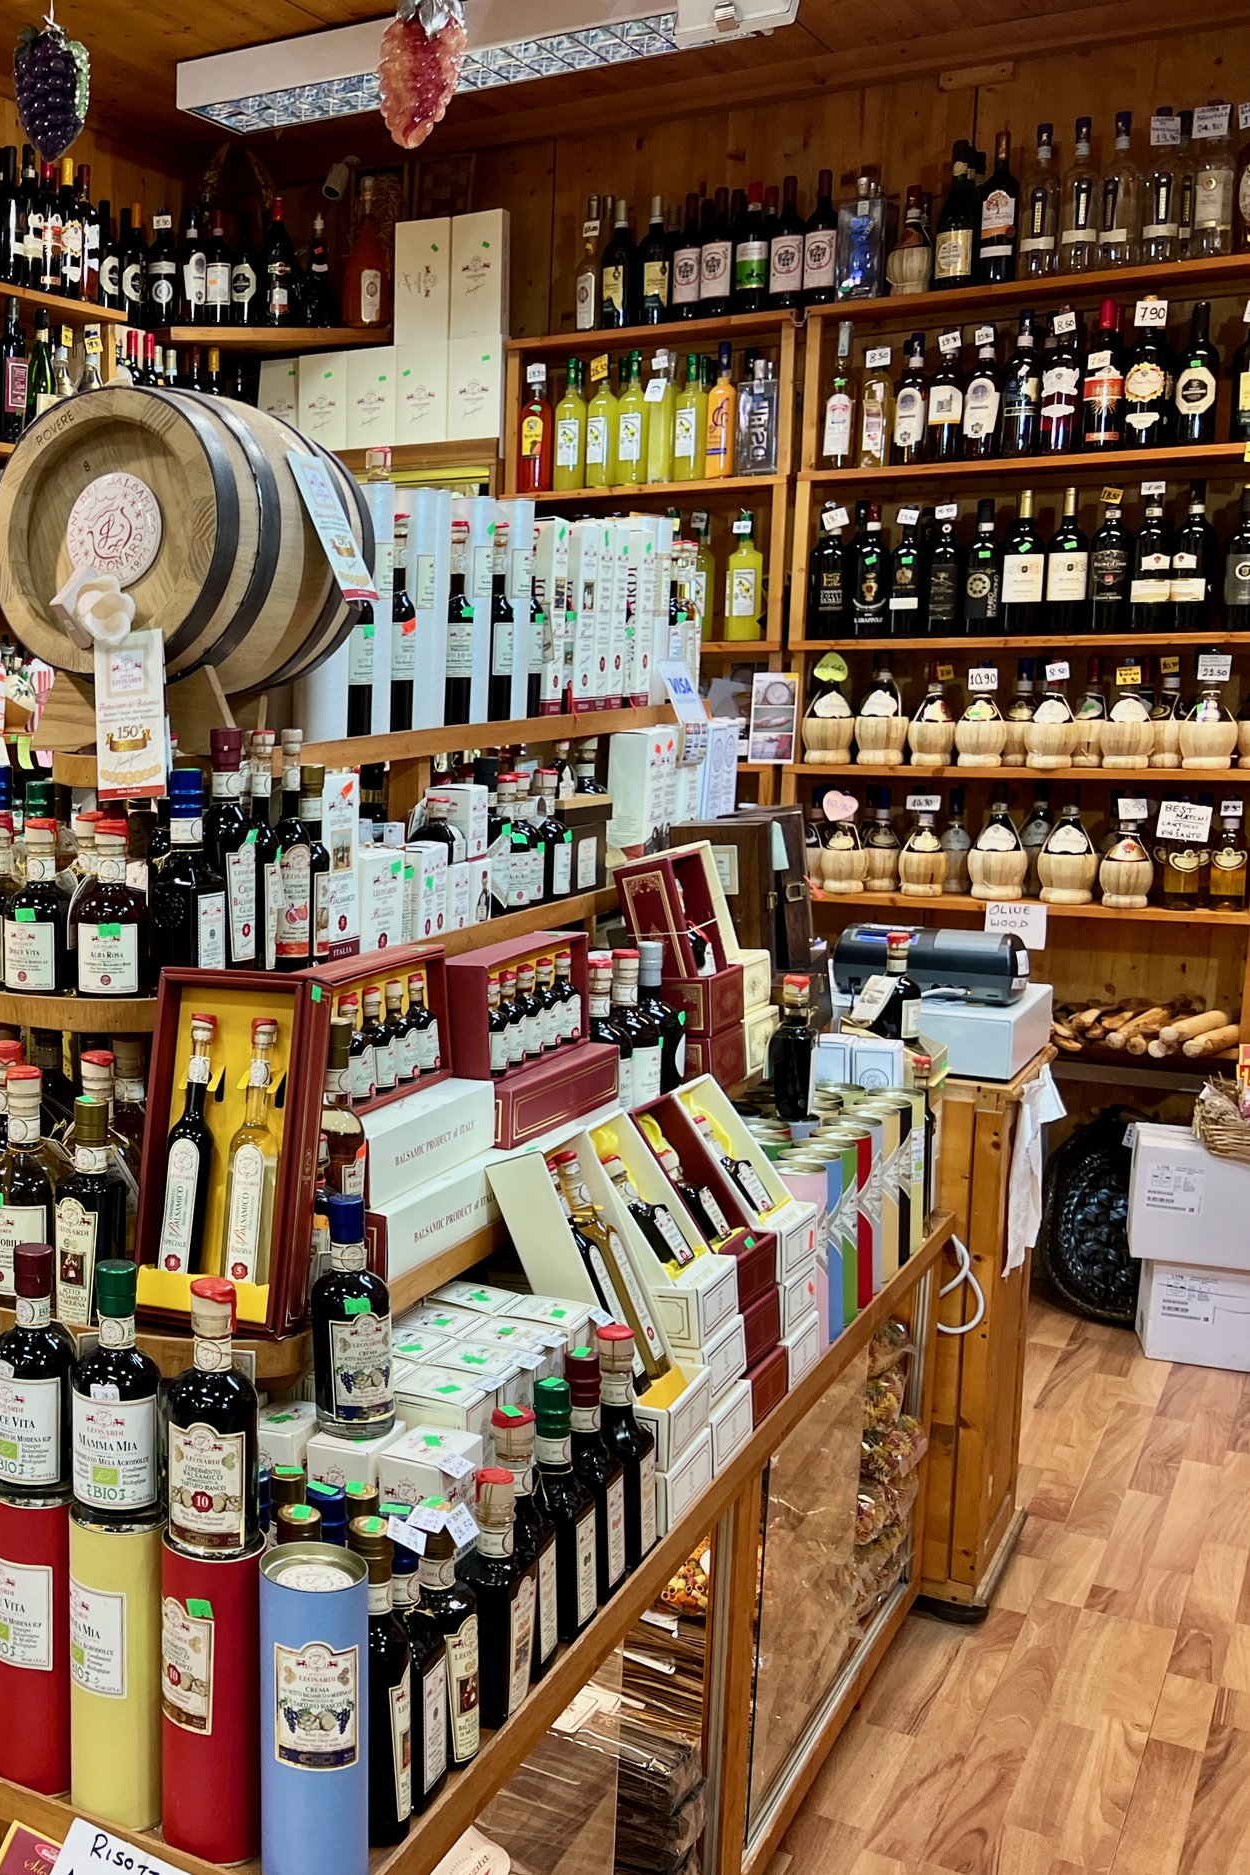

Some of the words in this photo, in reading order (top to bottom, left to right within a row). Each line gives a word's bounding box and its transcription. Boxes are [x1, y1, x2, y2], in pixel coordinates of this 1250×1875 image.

[1138, 306, 1165, 321] 7.90
[35, 410, 75, 447] ROVERE
[83, 460, 91, 472] 8
[91, 524, 145, 571] LEONARDI
[668, 677, 693, 694] VISA
[969, 671, 997, 686] 10.90
[1165, 804, 1196, 813] BEST
[989, 904, 1031, 916] OLIVE
[990, 918, 1029, 928] WOOD
[106, 951, 124, 959] ROSA
[395, 1144, 426, 1166] BALSAMIC
[426, 1131, 452, 1153] PRODUCT
[459, 1120, 475, 1136] ITALY
[168, 1185, 185, 1240] BALSAMICO
[233, 1192, 250, 1246] BALSAMICO
[414, 1221, 445, 1243] BALSAMIC
[445, 1204, 473, 1226] PRODUCT
[12, 1416, 36, 1429] VITA
[17, 1434, 42, 1443] MODENA
[78, 1433, 113, 1451] MAMMA
[116, 1440, 138, 1451] MIA
[92, 1485, 118, 1501] BIO
[195, 1494, 209, 1508] 10
[3, 1598, 25, 1613] VITA
[82, 1623, 101, 1640] MIA
[168, 1667, 178, 1681] 10
[305, 1686, 330, 1694] CREMA
